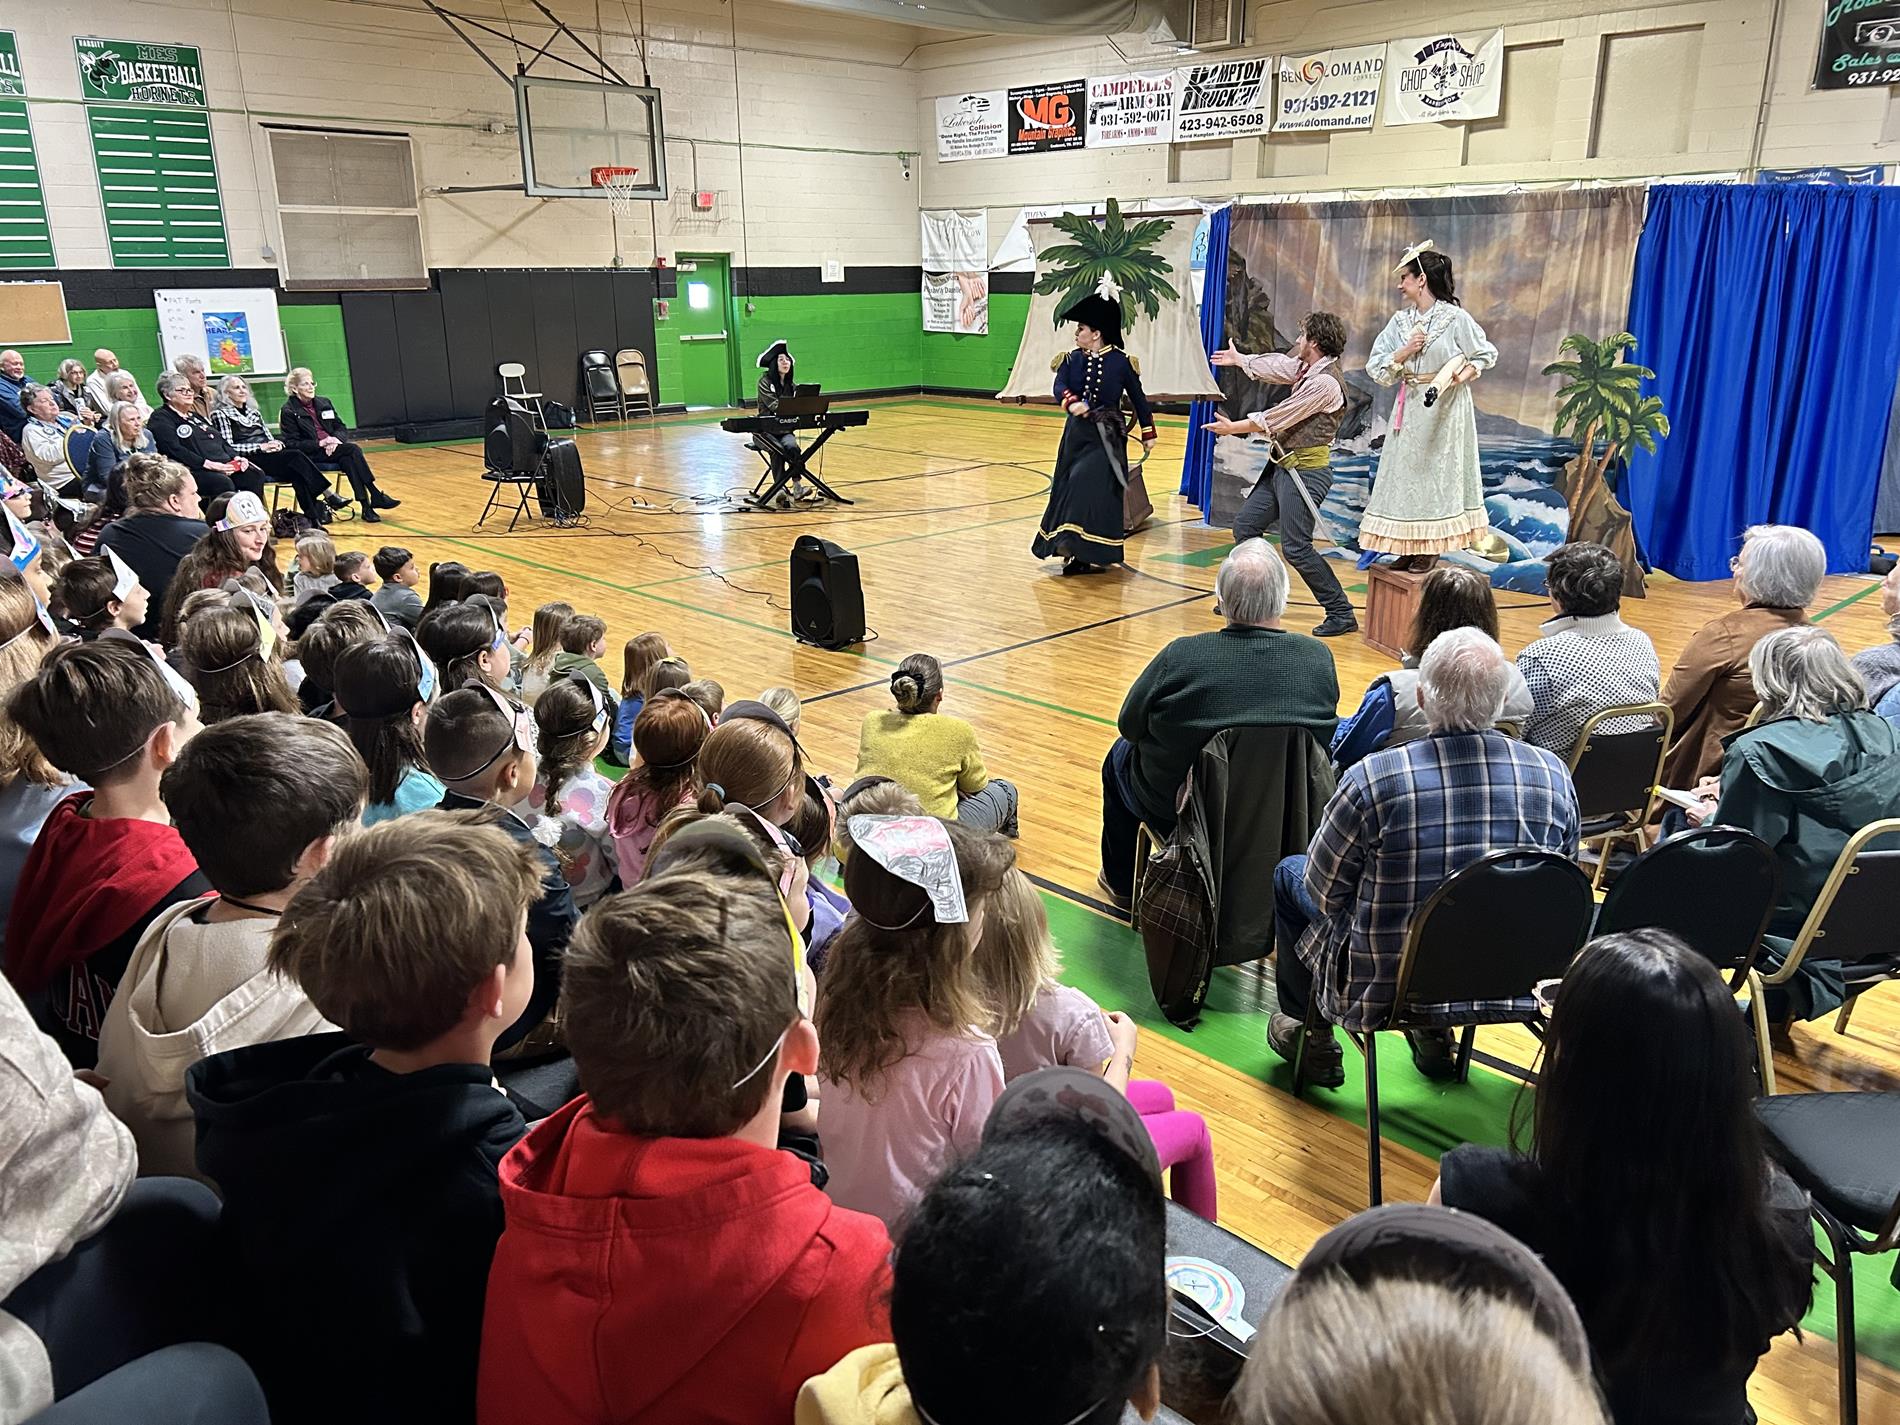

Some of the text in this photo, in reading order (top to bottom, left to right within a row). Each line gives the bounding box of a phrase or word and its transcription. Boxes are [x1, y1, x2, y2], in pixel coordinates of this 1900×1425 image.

[78, 39, 105, 49] VARSITY
[136, 45, 178, 62] MES
[1832, 52, 1882, 71] Sales
[118, 61, 203, 91] BASKETBALL
[1188, 59, 1266, 86] HAMPTON
[1280, 70, 1303, 83] BEN
[1400, 68, 1428, 92] CHOP
[1458, 62, 1485, 87] SHOP
[130, 86, 196, 105] HORNETS
[1091, 76, 1173, 98] CAMPBELL'S
[1023, 94, 1069, 125] MG
[1283, 89, 1377, 114] 931-592-2121
[942, 114, 985, 129] Lakeside
[969, 123, 1002, 131] Collision
[1100, 108, 1171, 127] 931-592-0071
[1179, 113, 1264, 131] 423-942-6508
[1017, 128, 1046, 141] Mountain
[1047, 125, 1076, 141] Graphics
